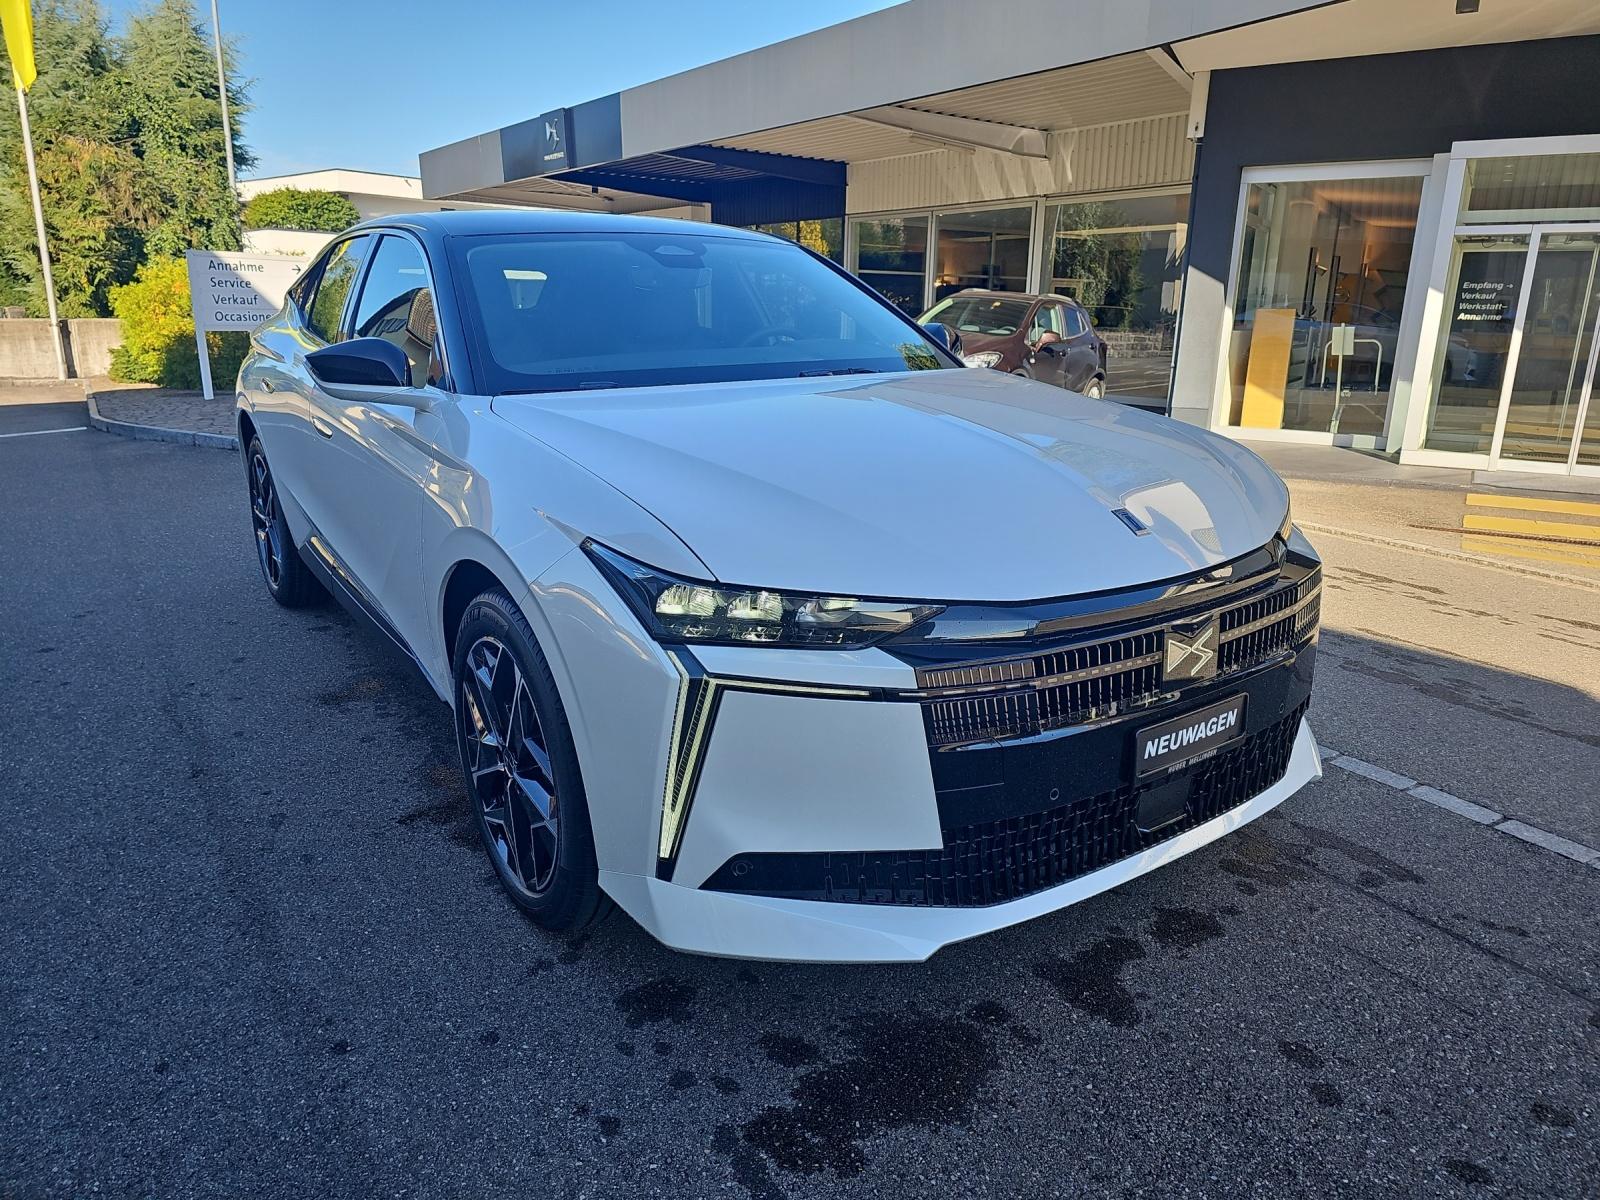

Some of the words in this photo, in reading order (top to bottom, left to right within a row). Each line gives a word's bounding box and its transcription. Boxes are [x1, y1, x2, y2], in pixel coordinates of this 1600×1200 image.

[208, 260, 264, 272] Annahme
[210, 276, 252, 288] Service
[1462, 282, 1504, 290] Empfang
[212, 293, 258, 305] Verkauf
[214, 310, 274, 322] Occasione
[1457, 312, 1502, 320] Annahme
[1143, 708, 1238, 760] NEUWAGEN
